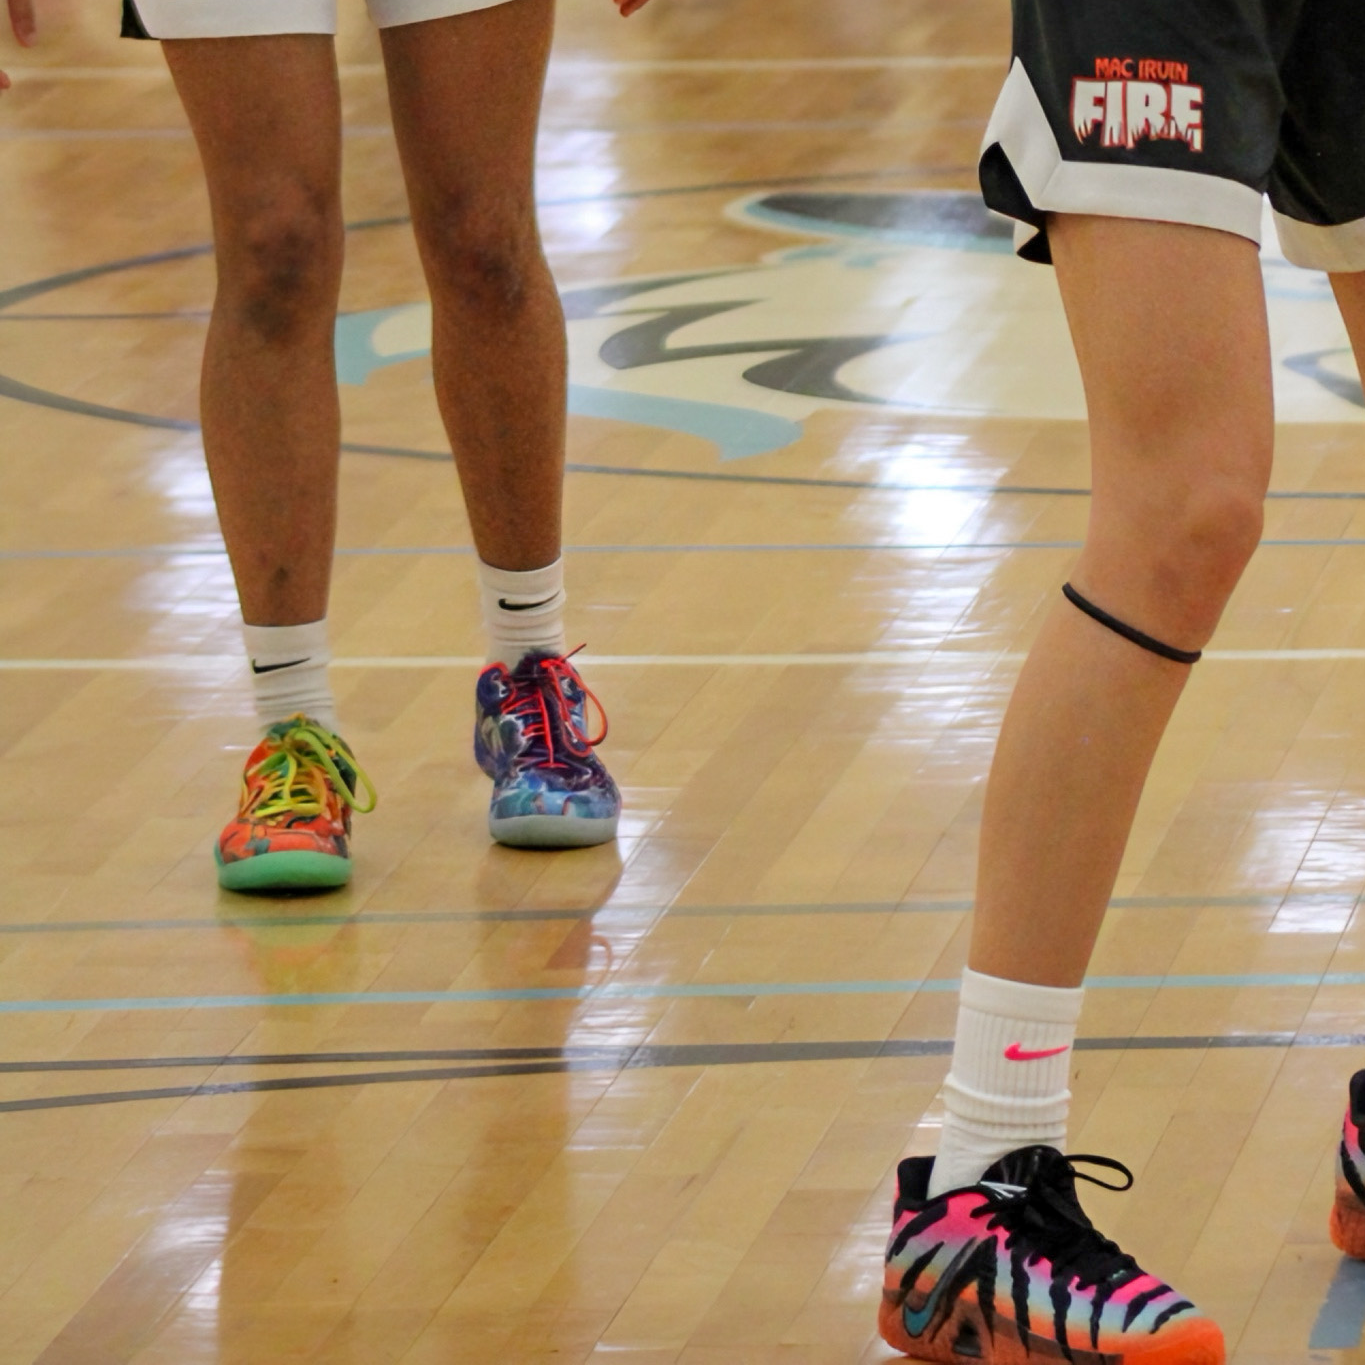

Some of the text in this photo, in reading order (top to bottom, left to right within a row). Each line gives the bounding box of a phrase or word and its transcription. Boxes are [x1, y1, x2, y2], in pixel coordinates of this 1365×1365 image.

[1094, 57, 1189, 83] MAC IRVIN
[1069, 77, 1203, 152] FIRE
